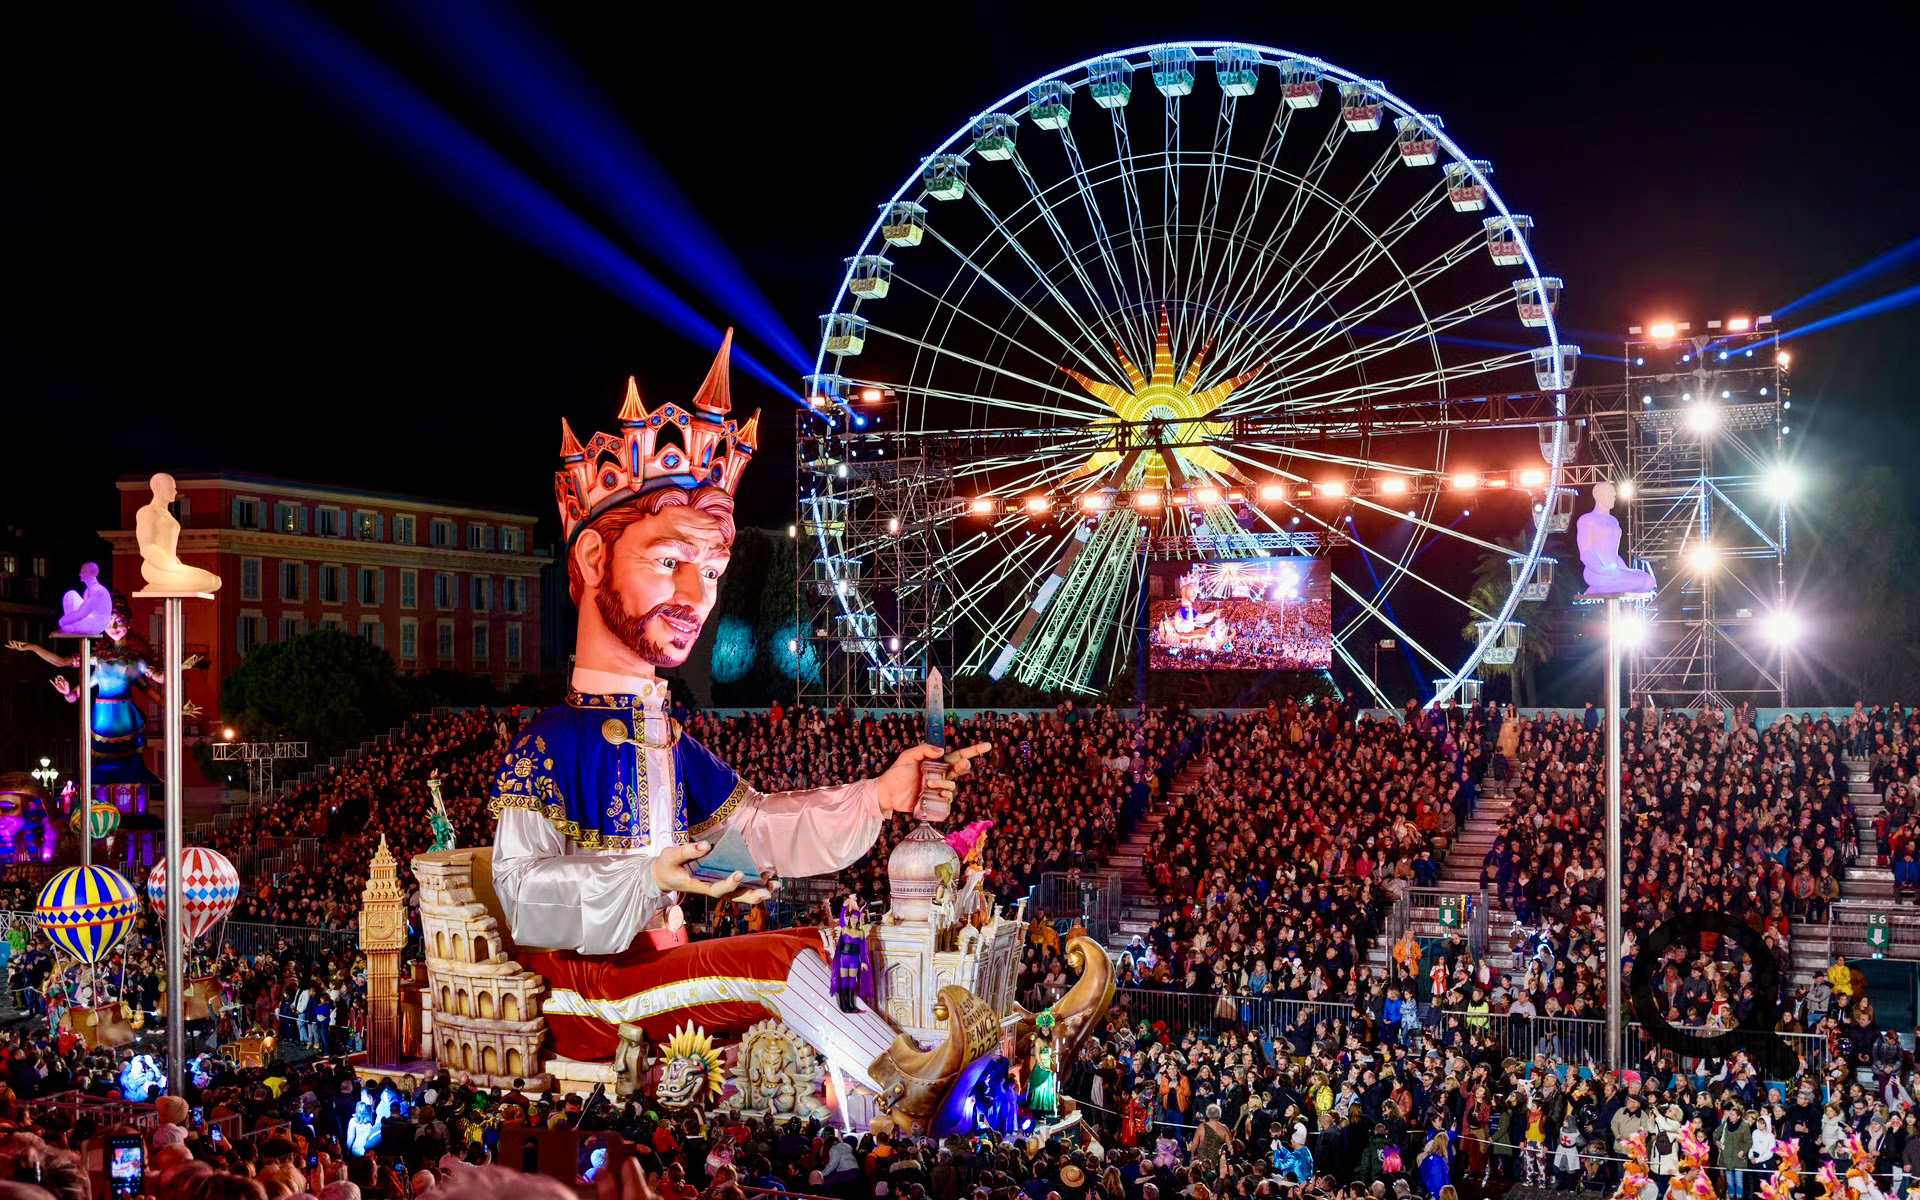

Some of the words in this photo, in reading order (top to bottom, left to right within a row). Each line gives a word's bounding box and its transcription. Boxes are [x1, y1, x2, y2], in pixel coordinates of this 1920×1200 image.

[963, 1003, 990, 1029] CARNAVAL
[966, 1029, 977, 1045] DE
[976, 1013, 997, 1043] NICE
[970, 1031, 998, 1062] 2023
